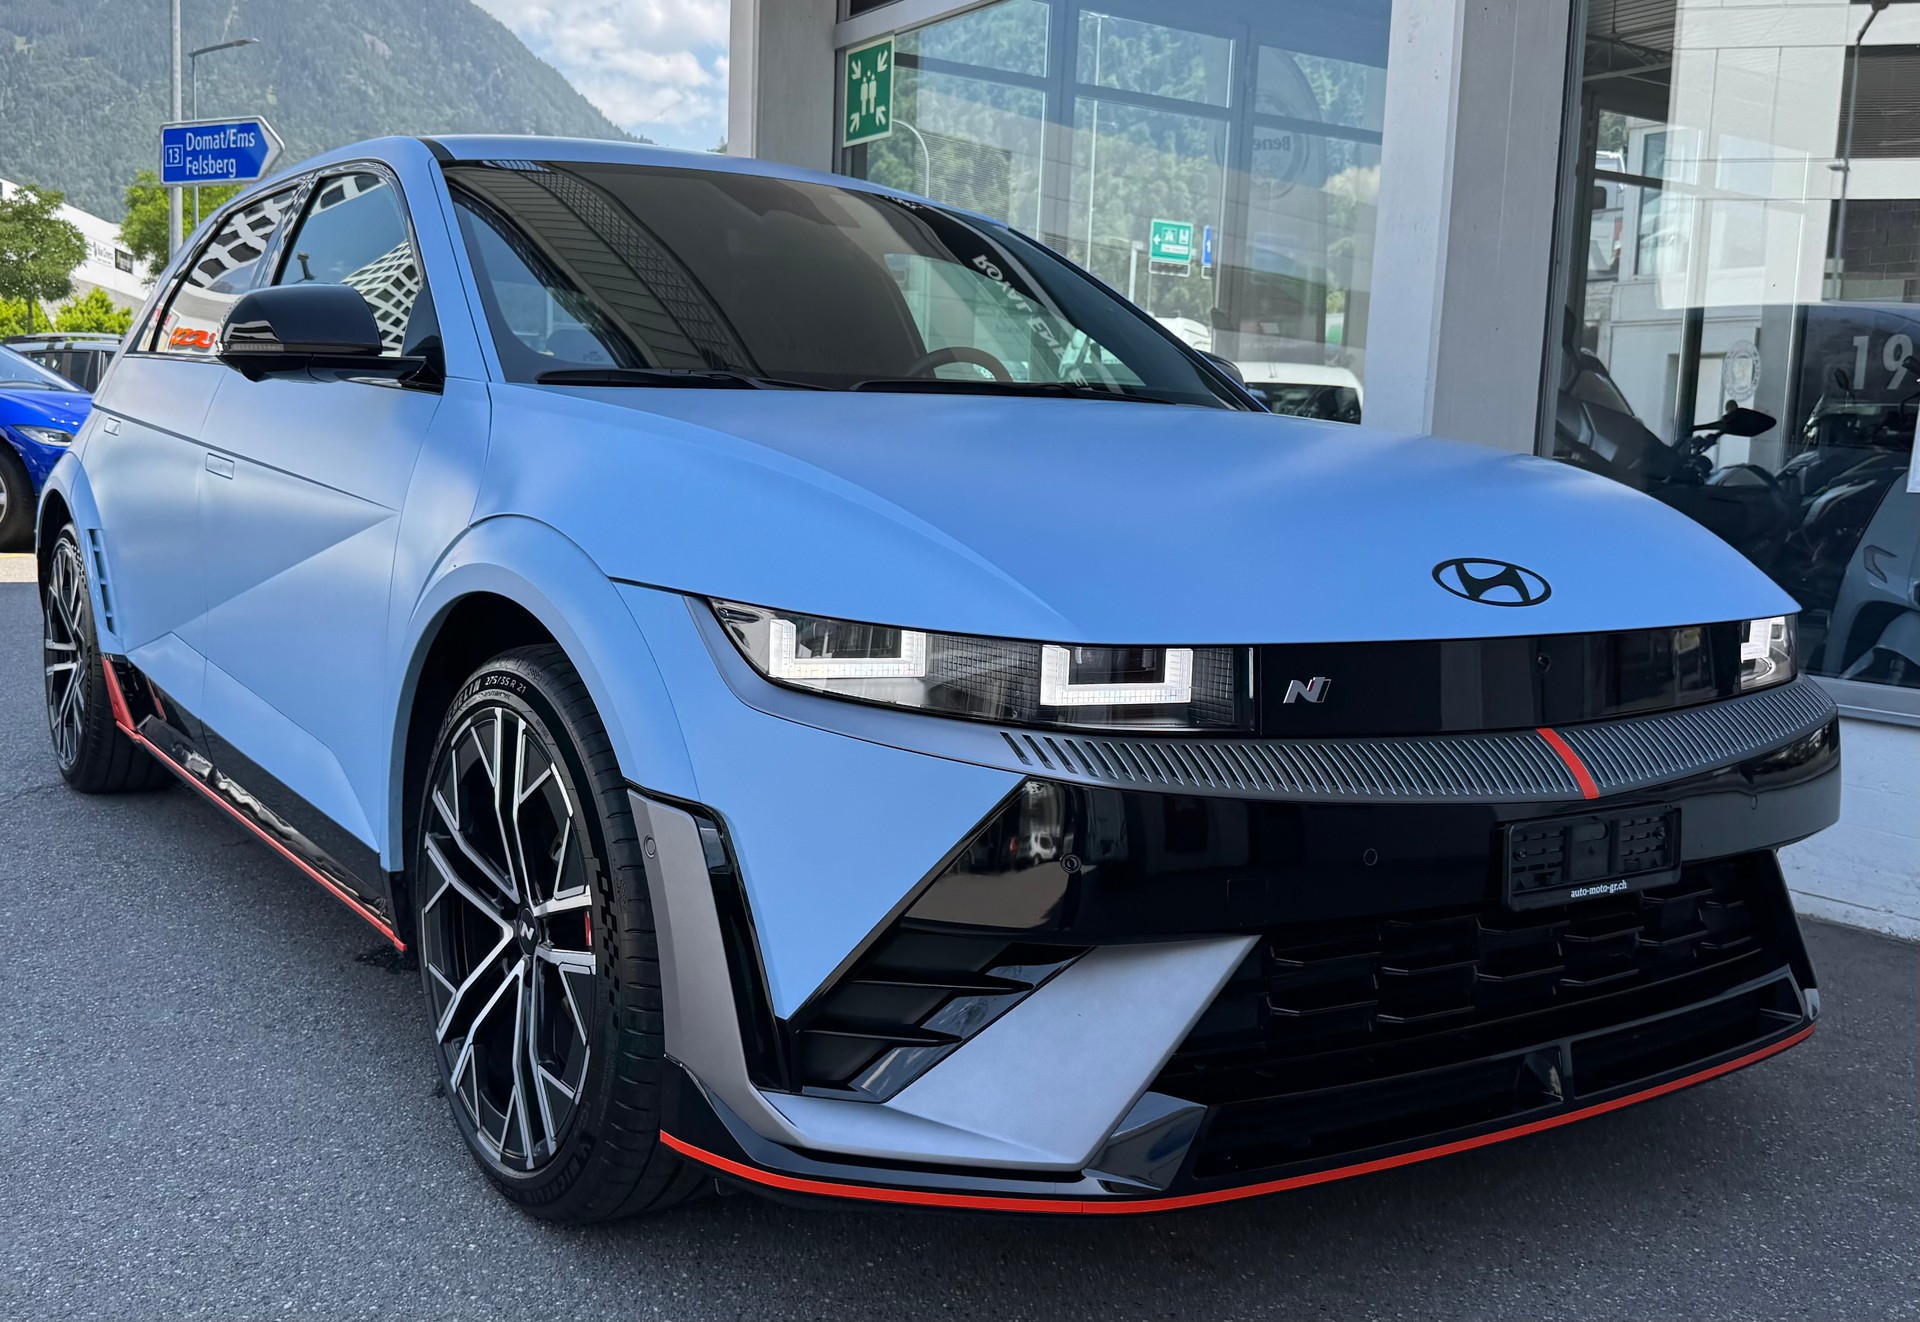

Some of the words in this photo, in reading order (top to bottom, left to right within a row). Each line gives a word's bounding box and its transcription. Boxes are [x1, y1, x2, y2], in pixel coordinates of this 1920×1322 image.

[186, 128, 255, 151] Domat/Ems
[168, 148, 180, 164] 13
[186, 154, 237, 178] Felsberg
[1853, 334, 1914, 390] 19
[484, 675, 510, 686] 275/35
[510, 680, 516, 689] R
[517, 683, 527, 694] 21
[1283, 676, 1332, 704] N
[1570, 879, 1628, 898] auto-moto-gr.ch
[520, 920, 535, 941] N
